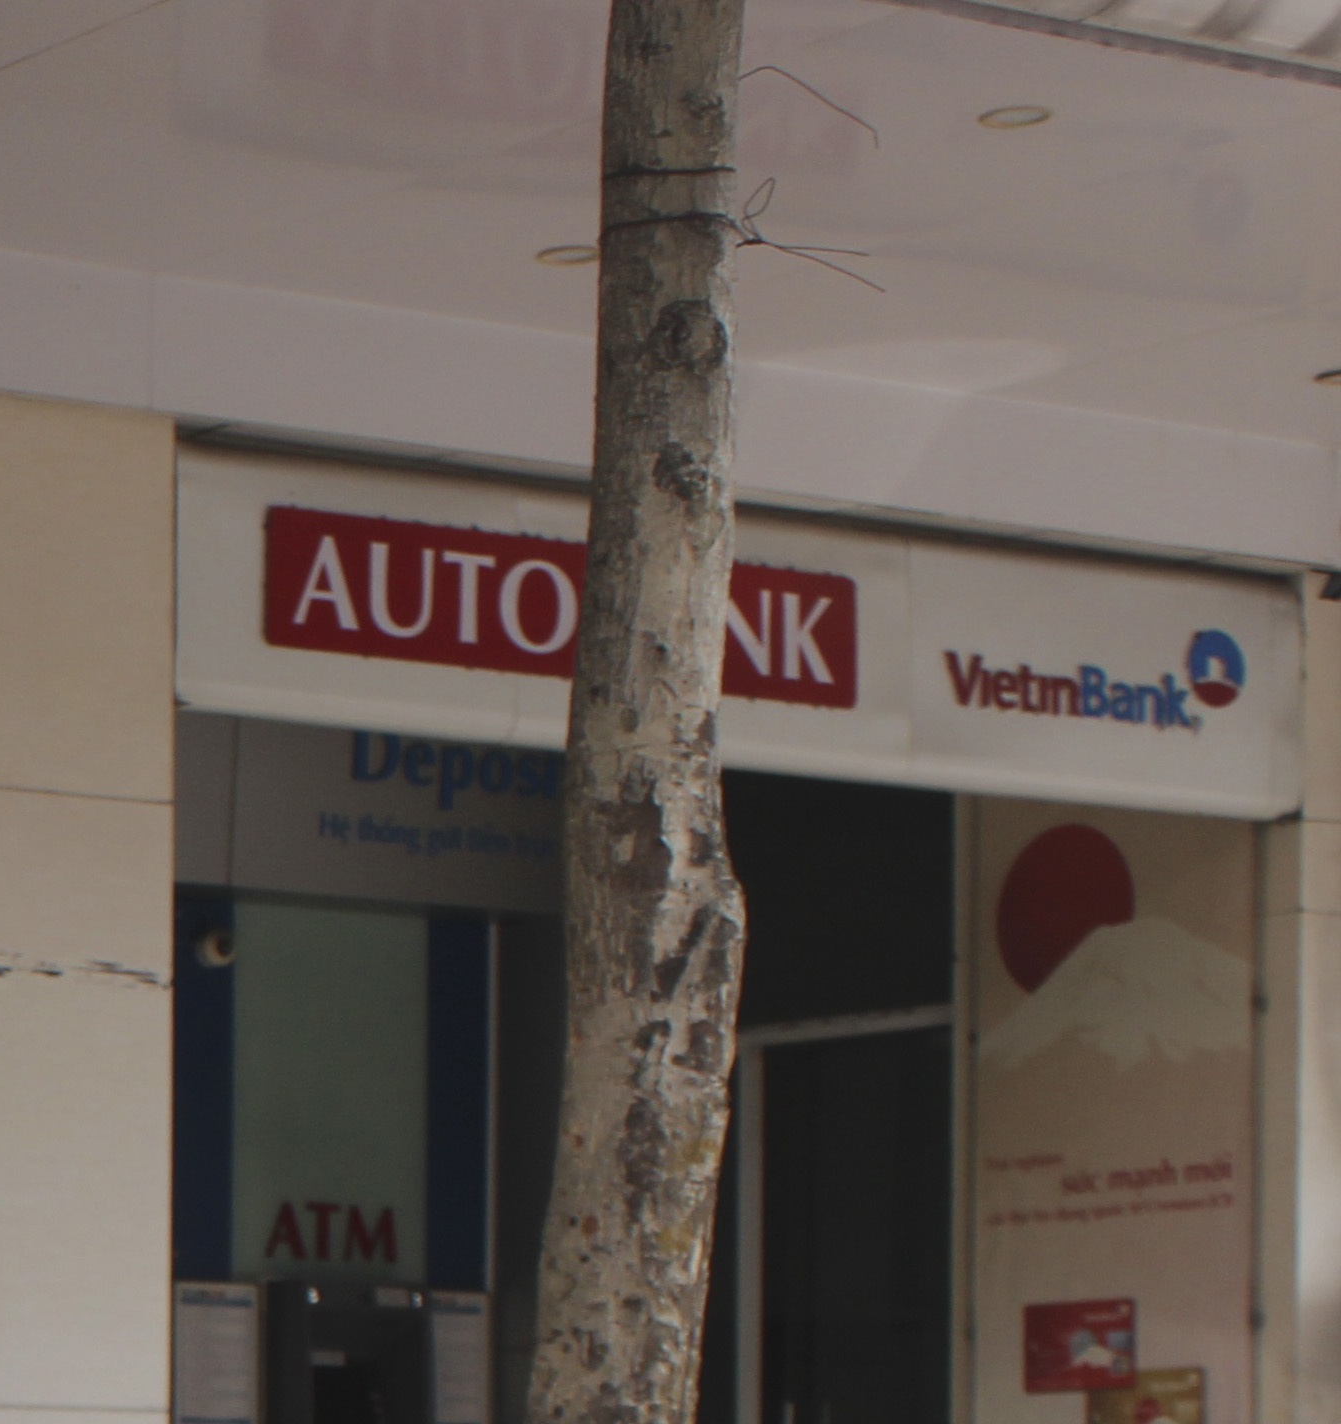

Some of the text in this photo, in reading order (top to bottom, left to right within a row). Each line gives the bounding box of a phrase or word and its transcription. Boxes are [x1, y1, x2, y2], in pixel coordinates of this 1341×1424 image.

[293, 536, 834, 685] AUTONK
[944, 650, 1192, 730] VietinBank
[265, 1200, 399, 1264] ATM
